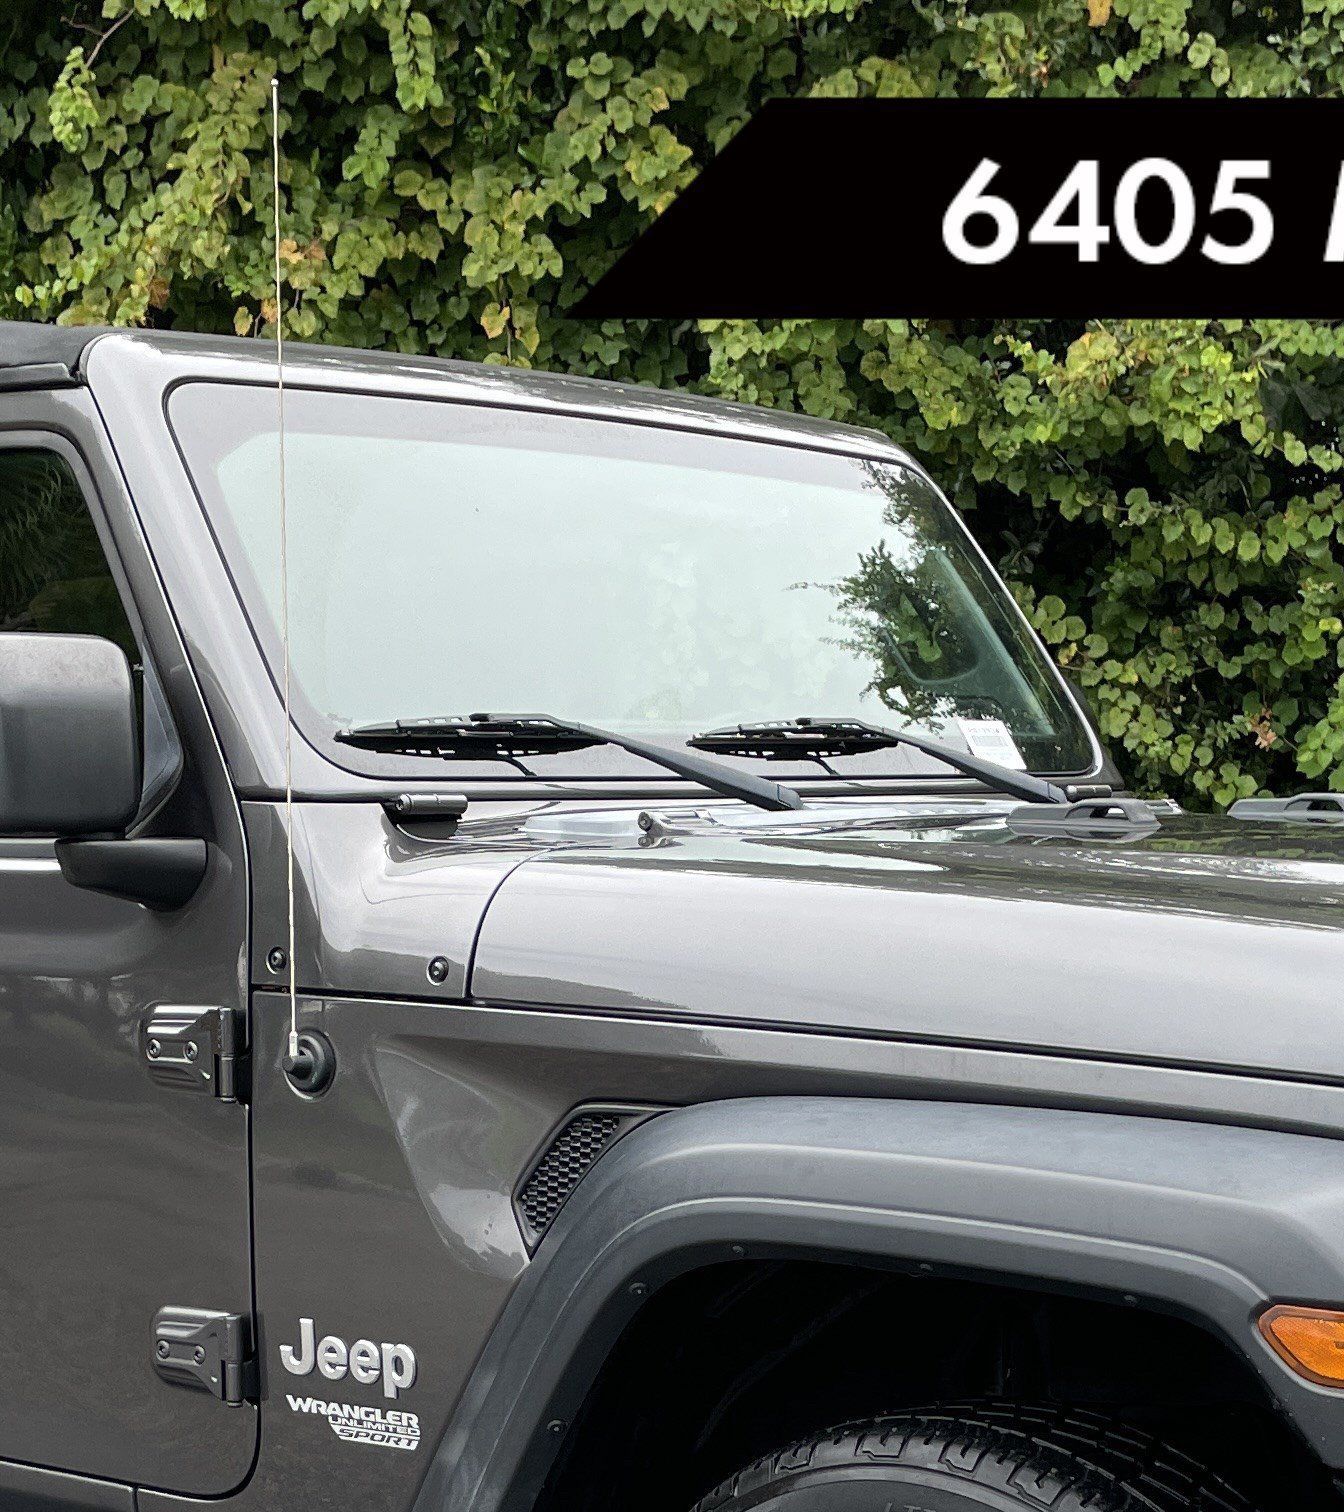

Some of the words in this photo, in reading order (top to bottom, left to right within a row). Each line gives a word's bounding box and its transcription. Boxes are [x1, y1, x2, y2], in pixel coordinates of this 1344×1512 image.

[279, 1317, 416, 1399] Jeep
[285, 1394, 419, 1428] WRANGLER
[328, 1414, 421, 1437] UNLIMITED
[338, 1427, 418, 1448] SPORT
